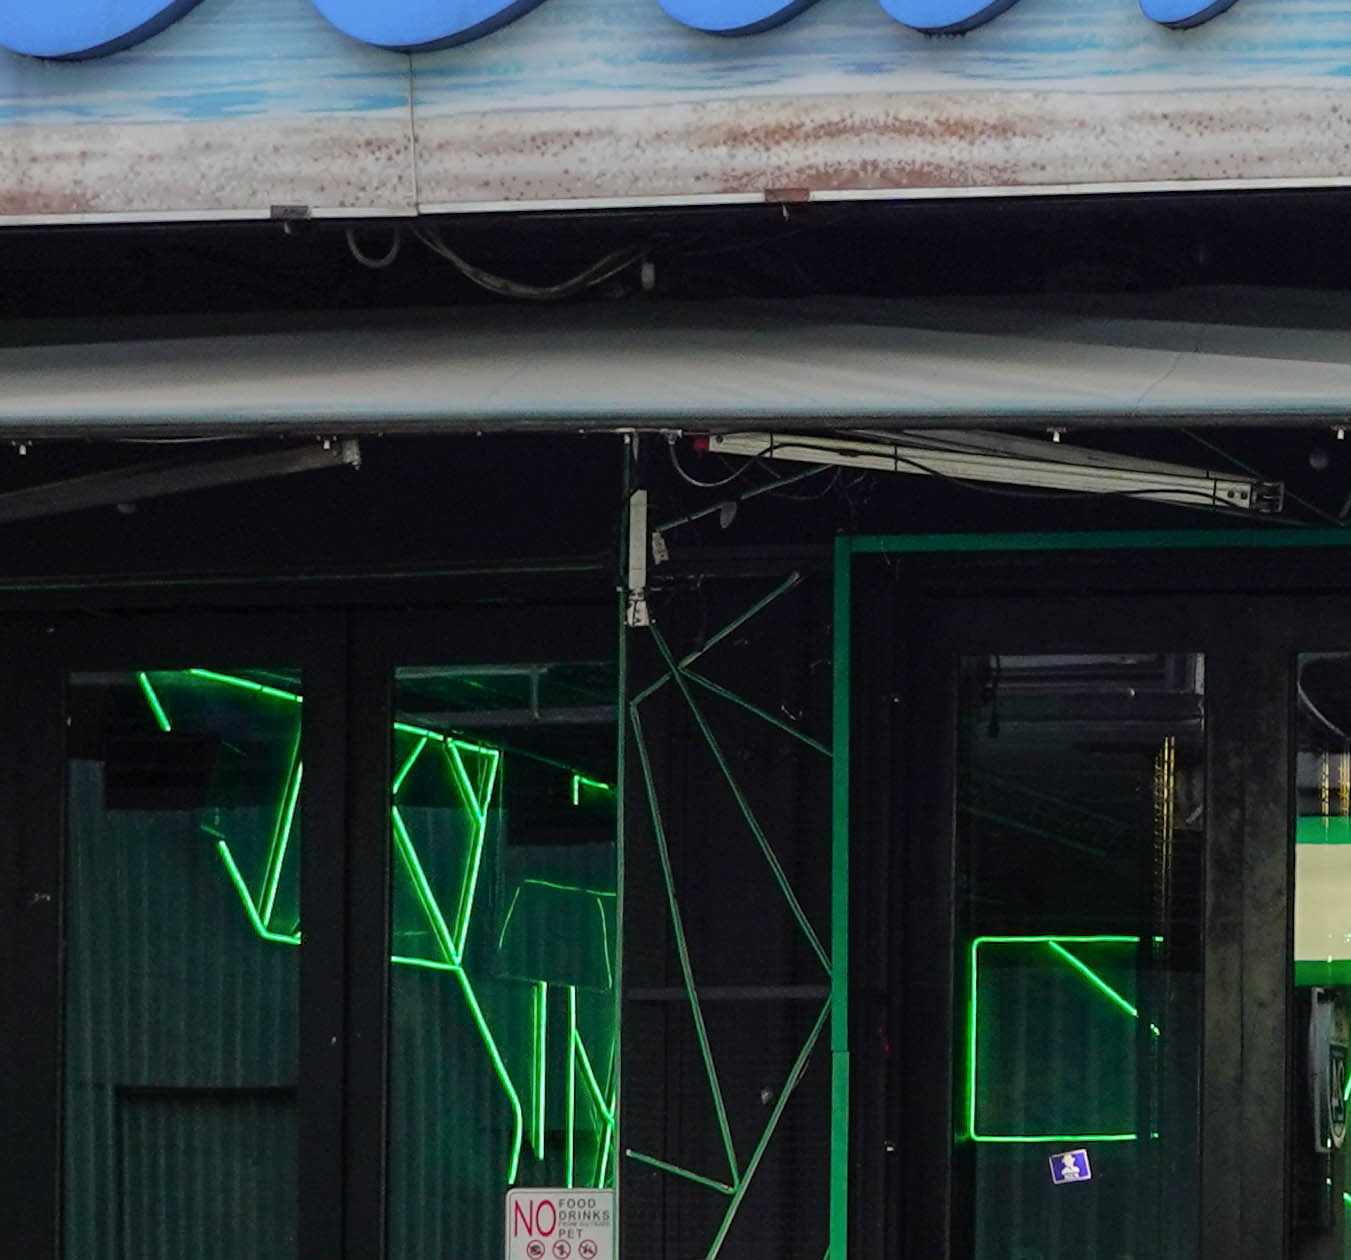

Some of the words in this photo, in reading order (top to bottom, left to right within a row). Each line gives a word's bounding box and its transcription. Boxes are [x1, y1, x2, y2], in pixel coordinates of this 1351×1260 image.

[558, 1199, 596, 1209] FOOD
[514, 1199, 557, 1237] NO
[558, 1210, 610, 1221] DRINKS
[558, 1228, 584, 1239] PET
